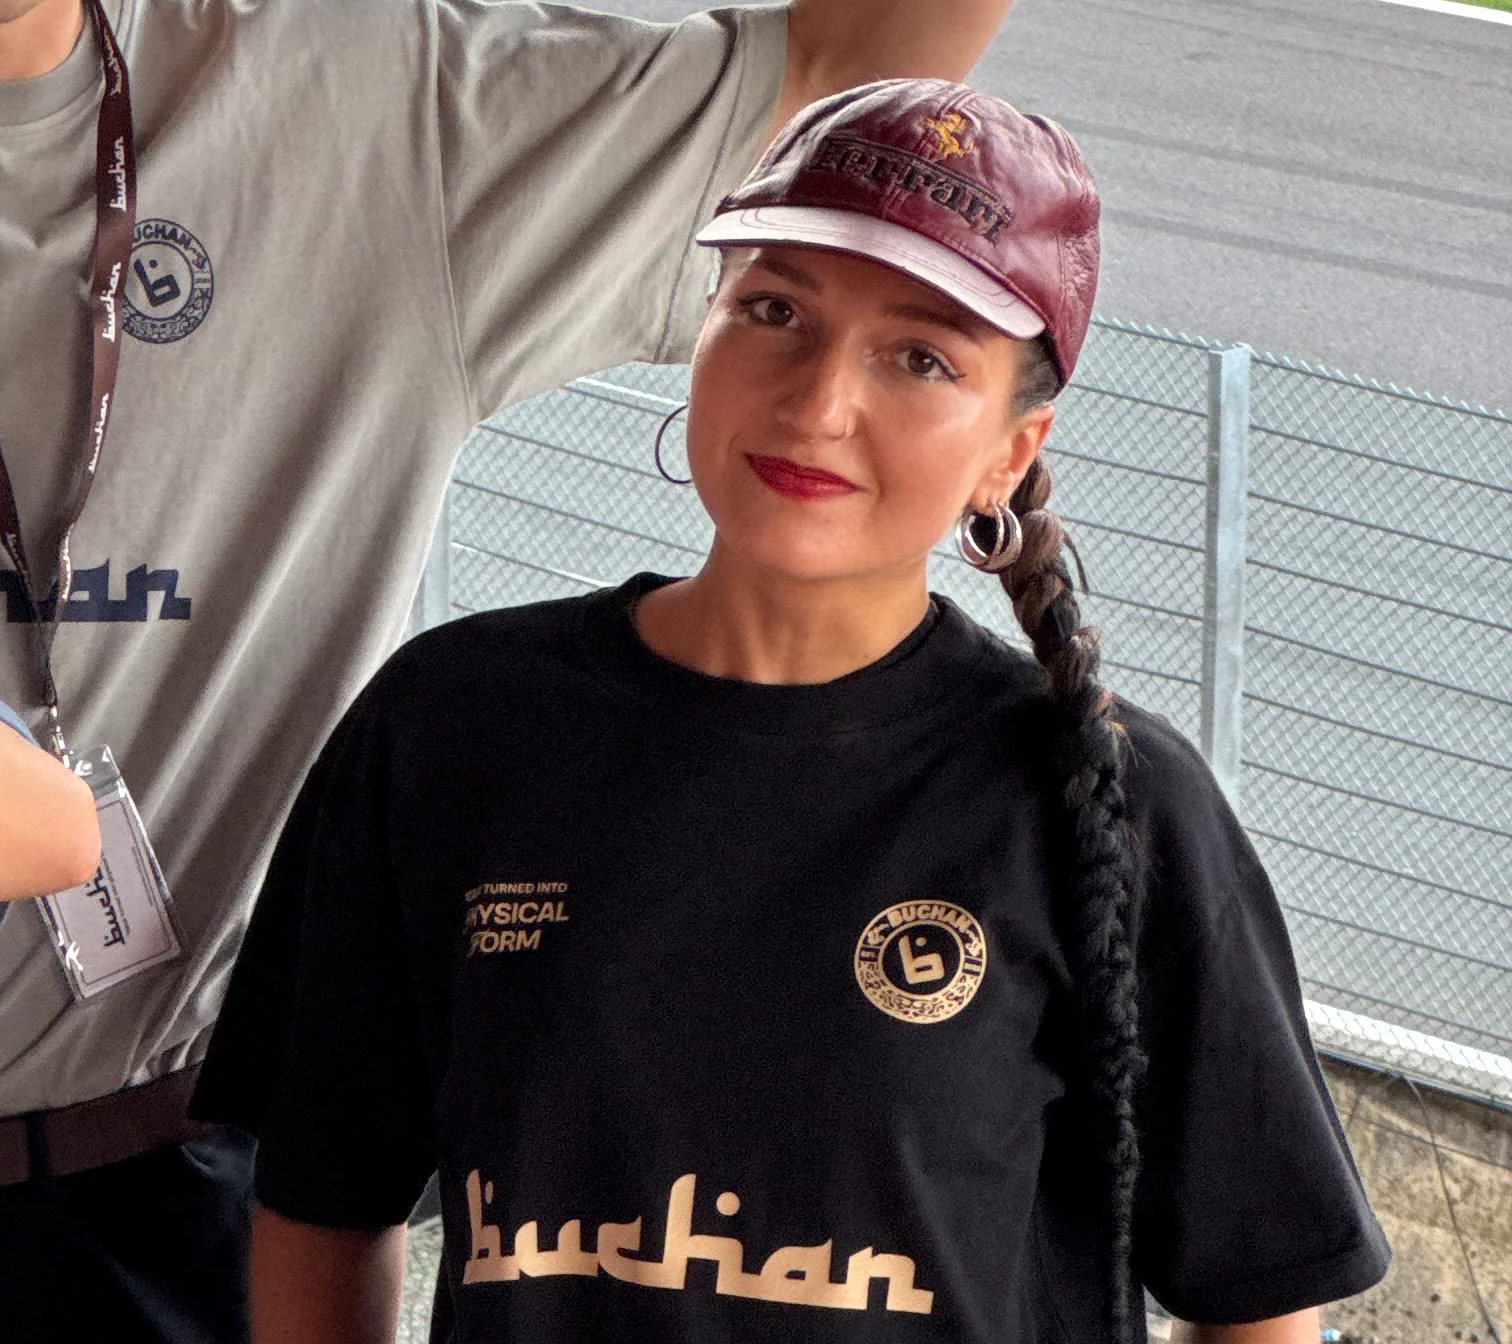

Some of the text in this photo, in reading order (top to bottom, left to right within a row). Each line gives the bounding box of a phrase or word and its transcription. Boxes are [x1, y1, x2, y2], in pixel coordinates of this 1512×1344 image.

[108, 136, 127, 213] buchan
[134, 223, 194, 250] UCHAN
[99, 261, 122, 344] buchan
[482, 882, 536, 896] TURNED
[536, 881, 569, 894] INTO
[886, 904, 974, 935] BUCHAN
[462, 1167, 935, 1315] buchan
